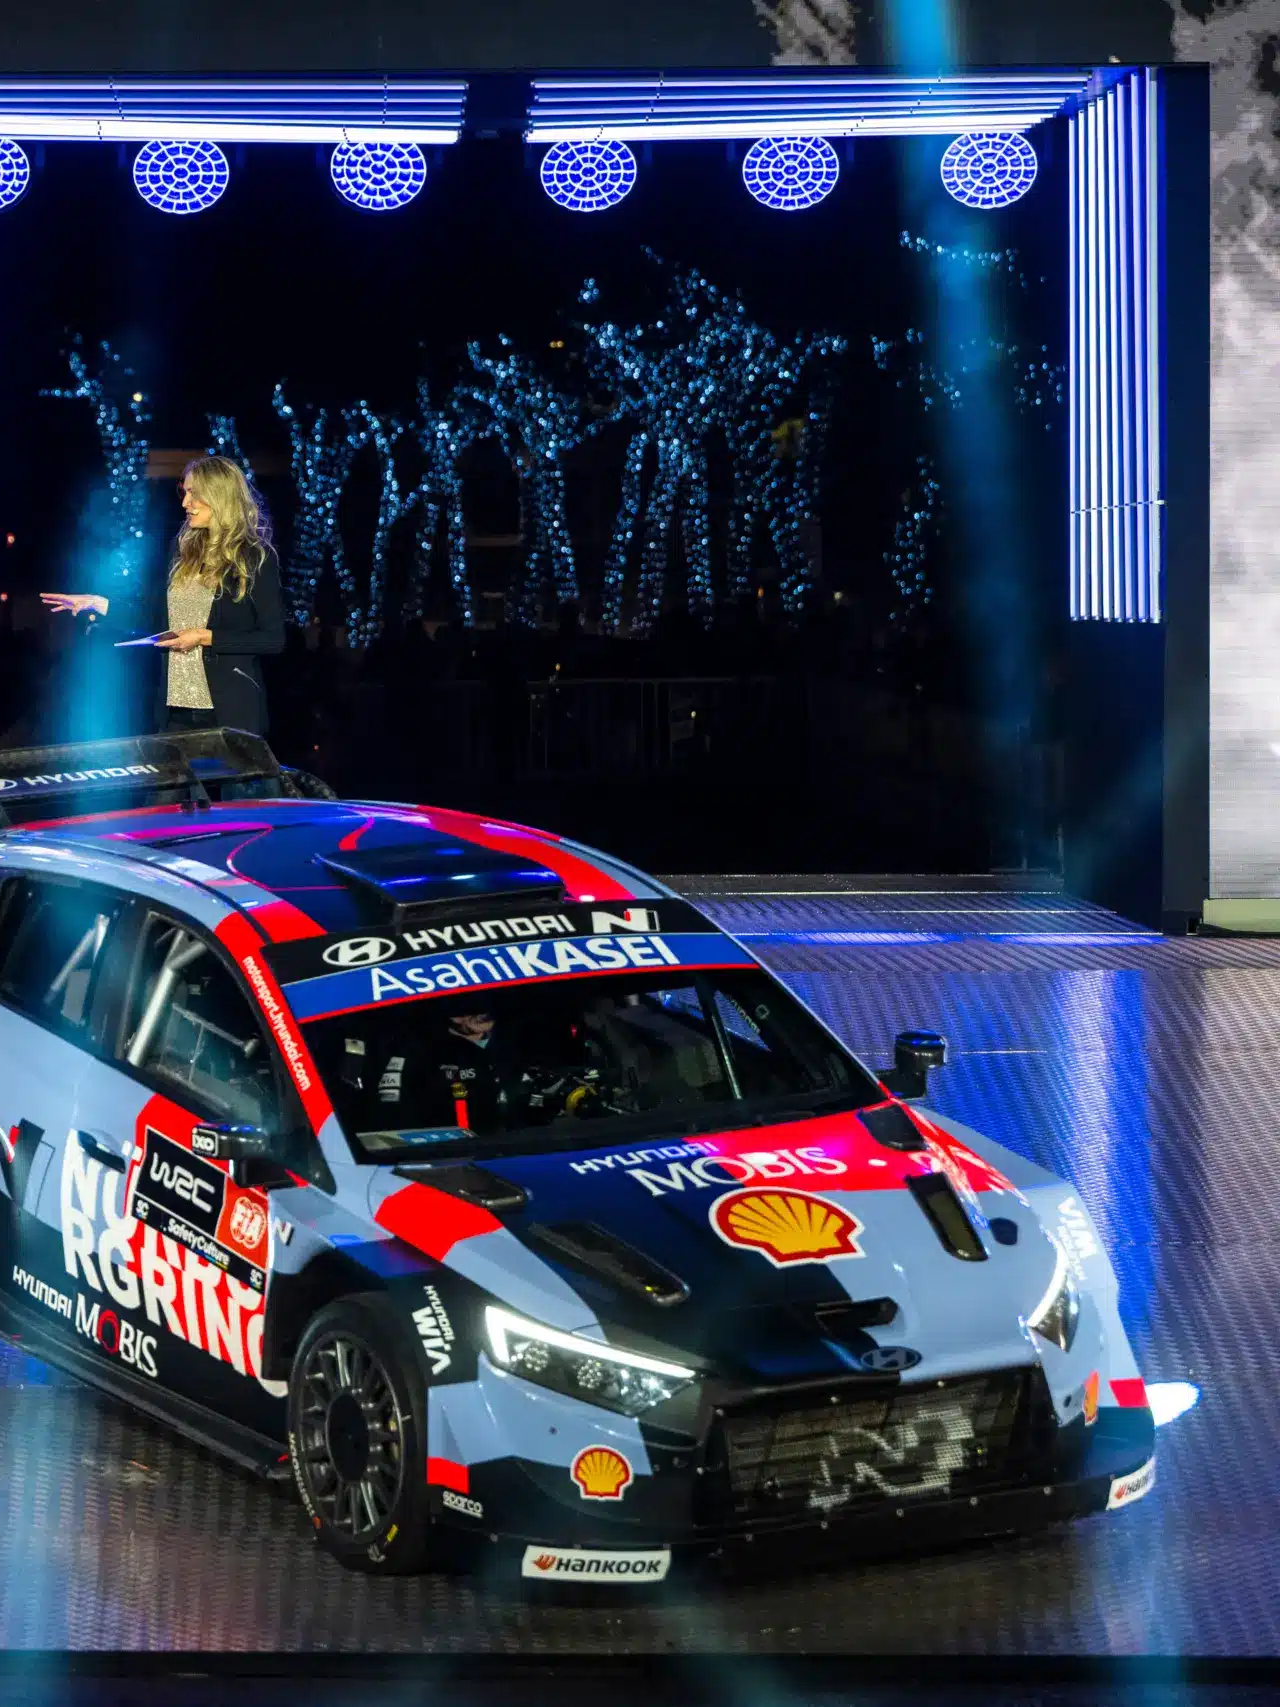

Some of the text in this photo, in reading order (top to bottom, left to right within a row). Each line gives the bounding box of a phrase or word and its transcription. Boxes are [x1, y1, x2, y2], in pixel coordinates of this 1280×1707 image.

[24, 763, 160, 787] HYUNDAI
[402, 913, 576, 952] HYUNDAI
[371, 935, 682, 1001] AsahiKASEI
[242, 955, 312, 1092] motorsport.hyundai.com
[150, 1152, 216, 1214] WRC
[569, 1141, 720, 1176] HYUNDAI
[624, 1146, 849, 1197] MOBIS
[167, 1217, 230, 1267] SafetyCulture
[233, 1202, 263, 1244] FIA
[12, 1265, 73, 1320] HYUNDAI
[249, 1268, 264, 1285] SC
[75, 1292, 159, 1378] MOBIS
[423, 1284, 457, 1342] HYUNDAI
[442, 1490, 484, 1514] sparco
